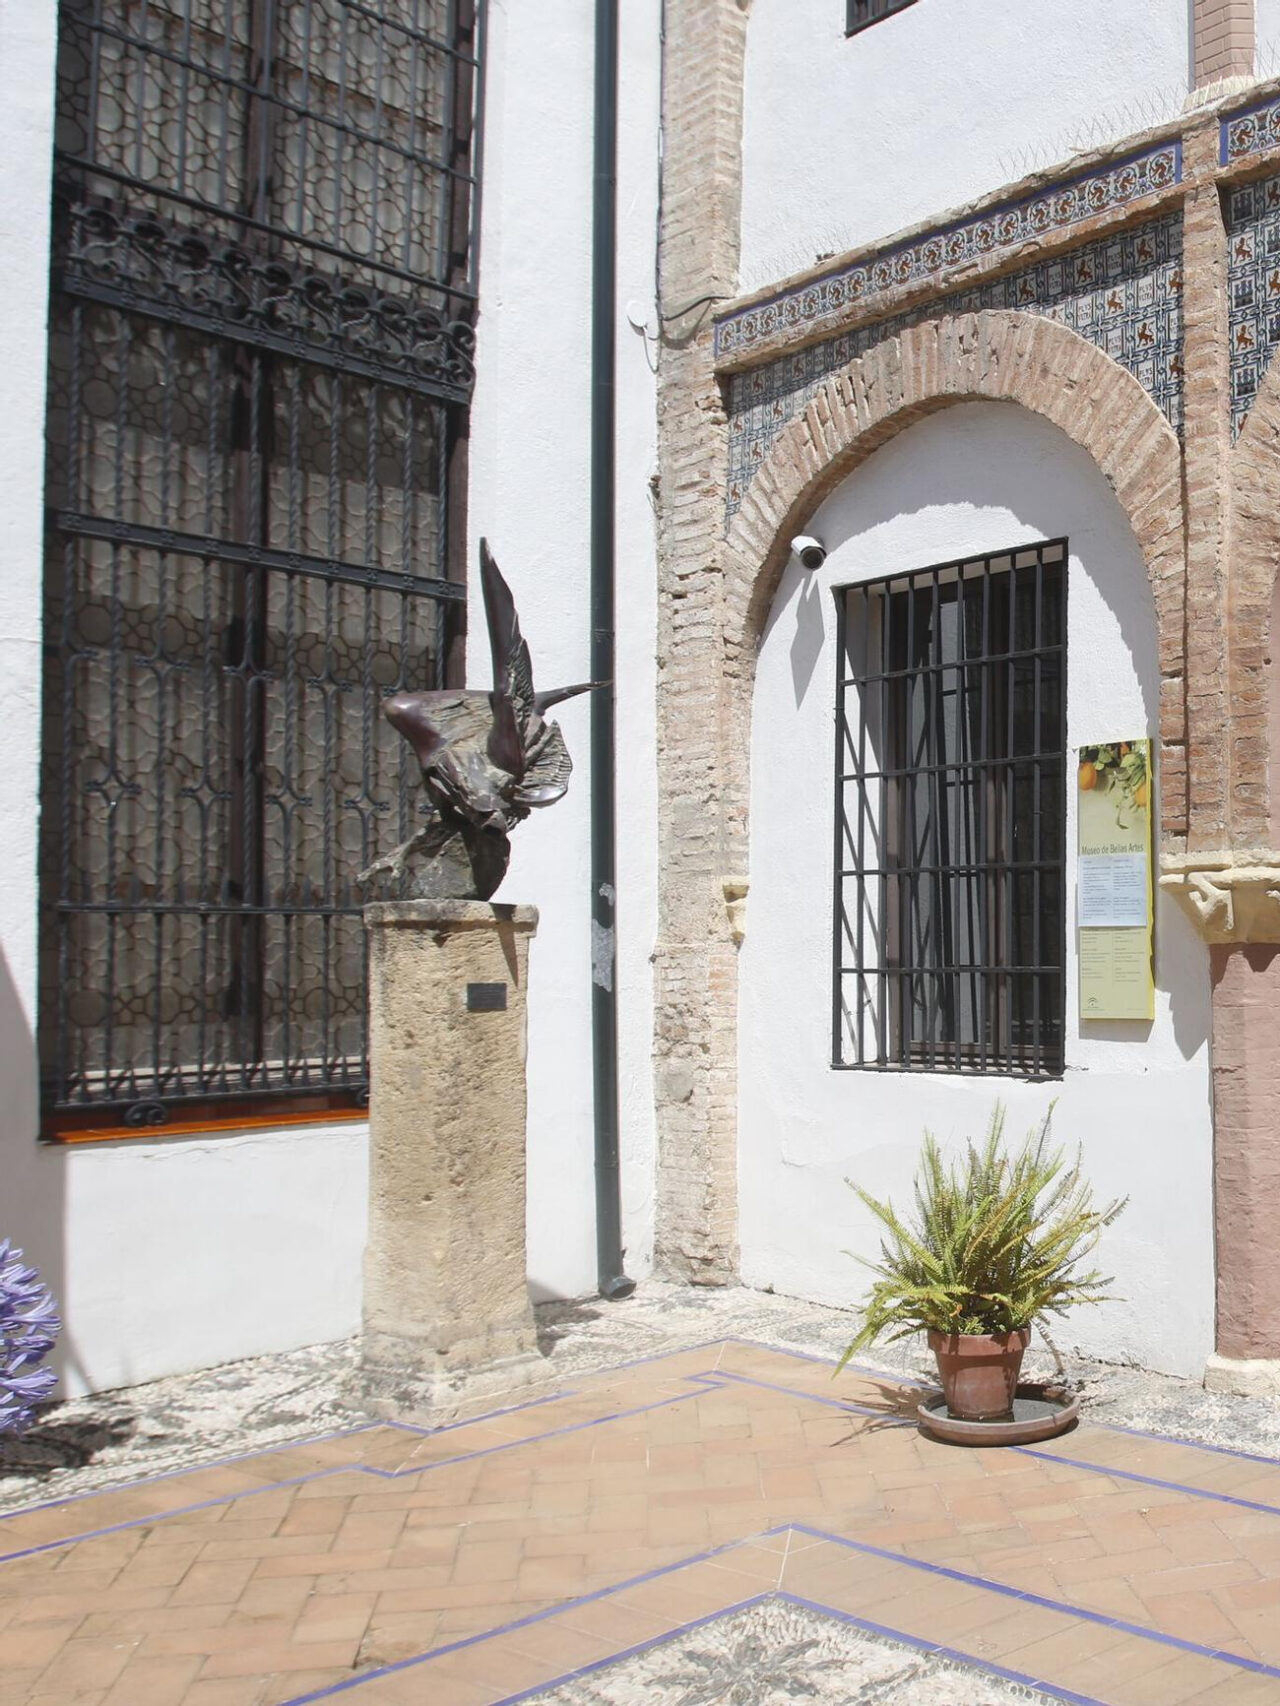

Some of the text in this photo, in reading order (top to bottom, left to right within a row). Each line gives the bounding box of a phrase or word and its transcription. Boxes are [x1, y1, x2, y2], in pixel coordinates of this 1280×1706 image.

[1081, 843, 1144, 855] Museo de Bellas Artes
